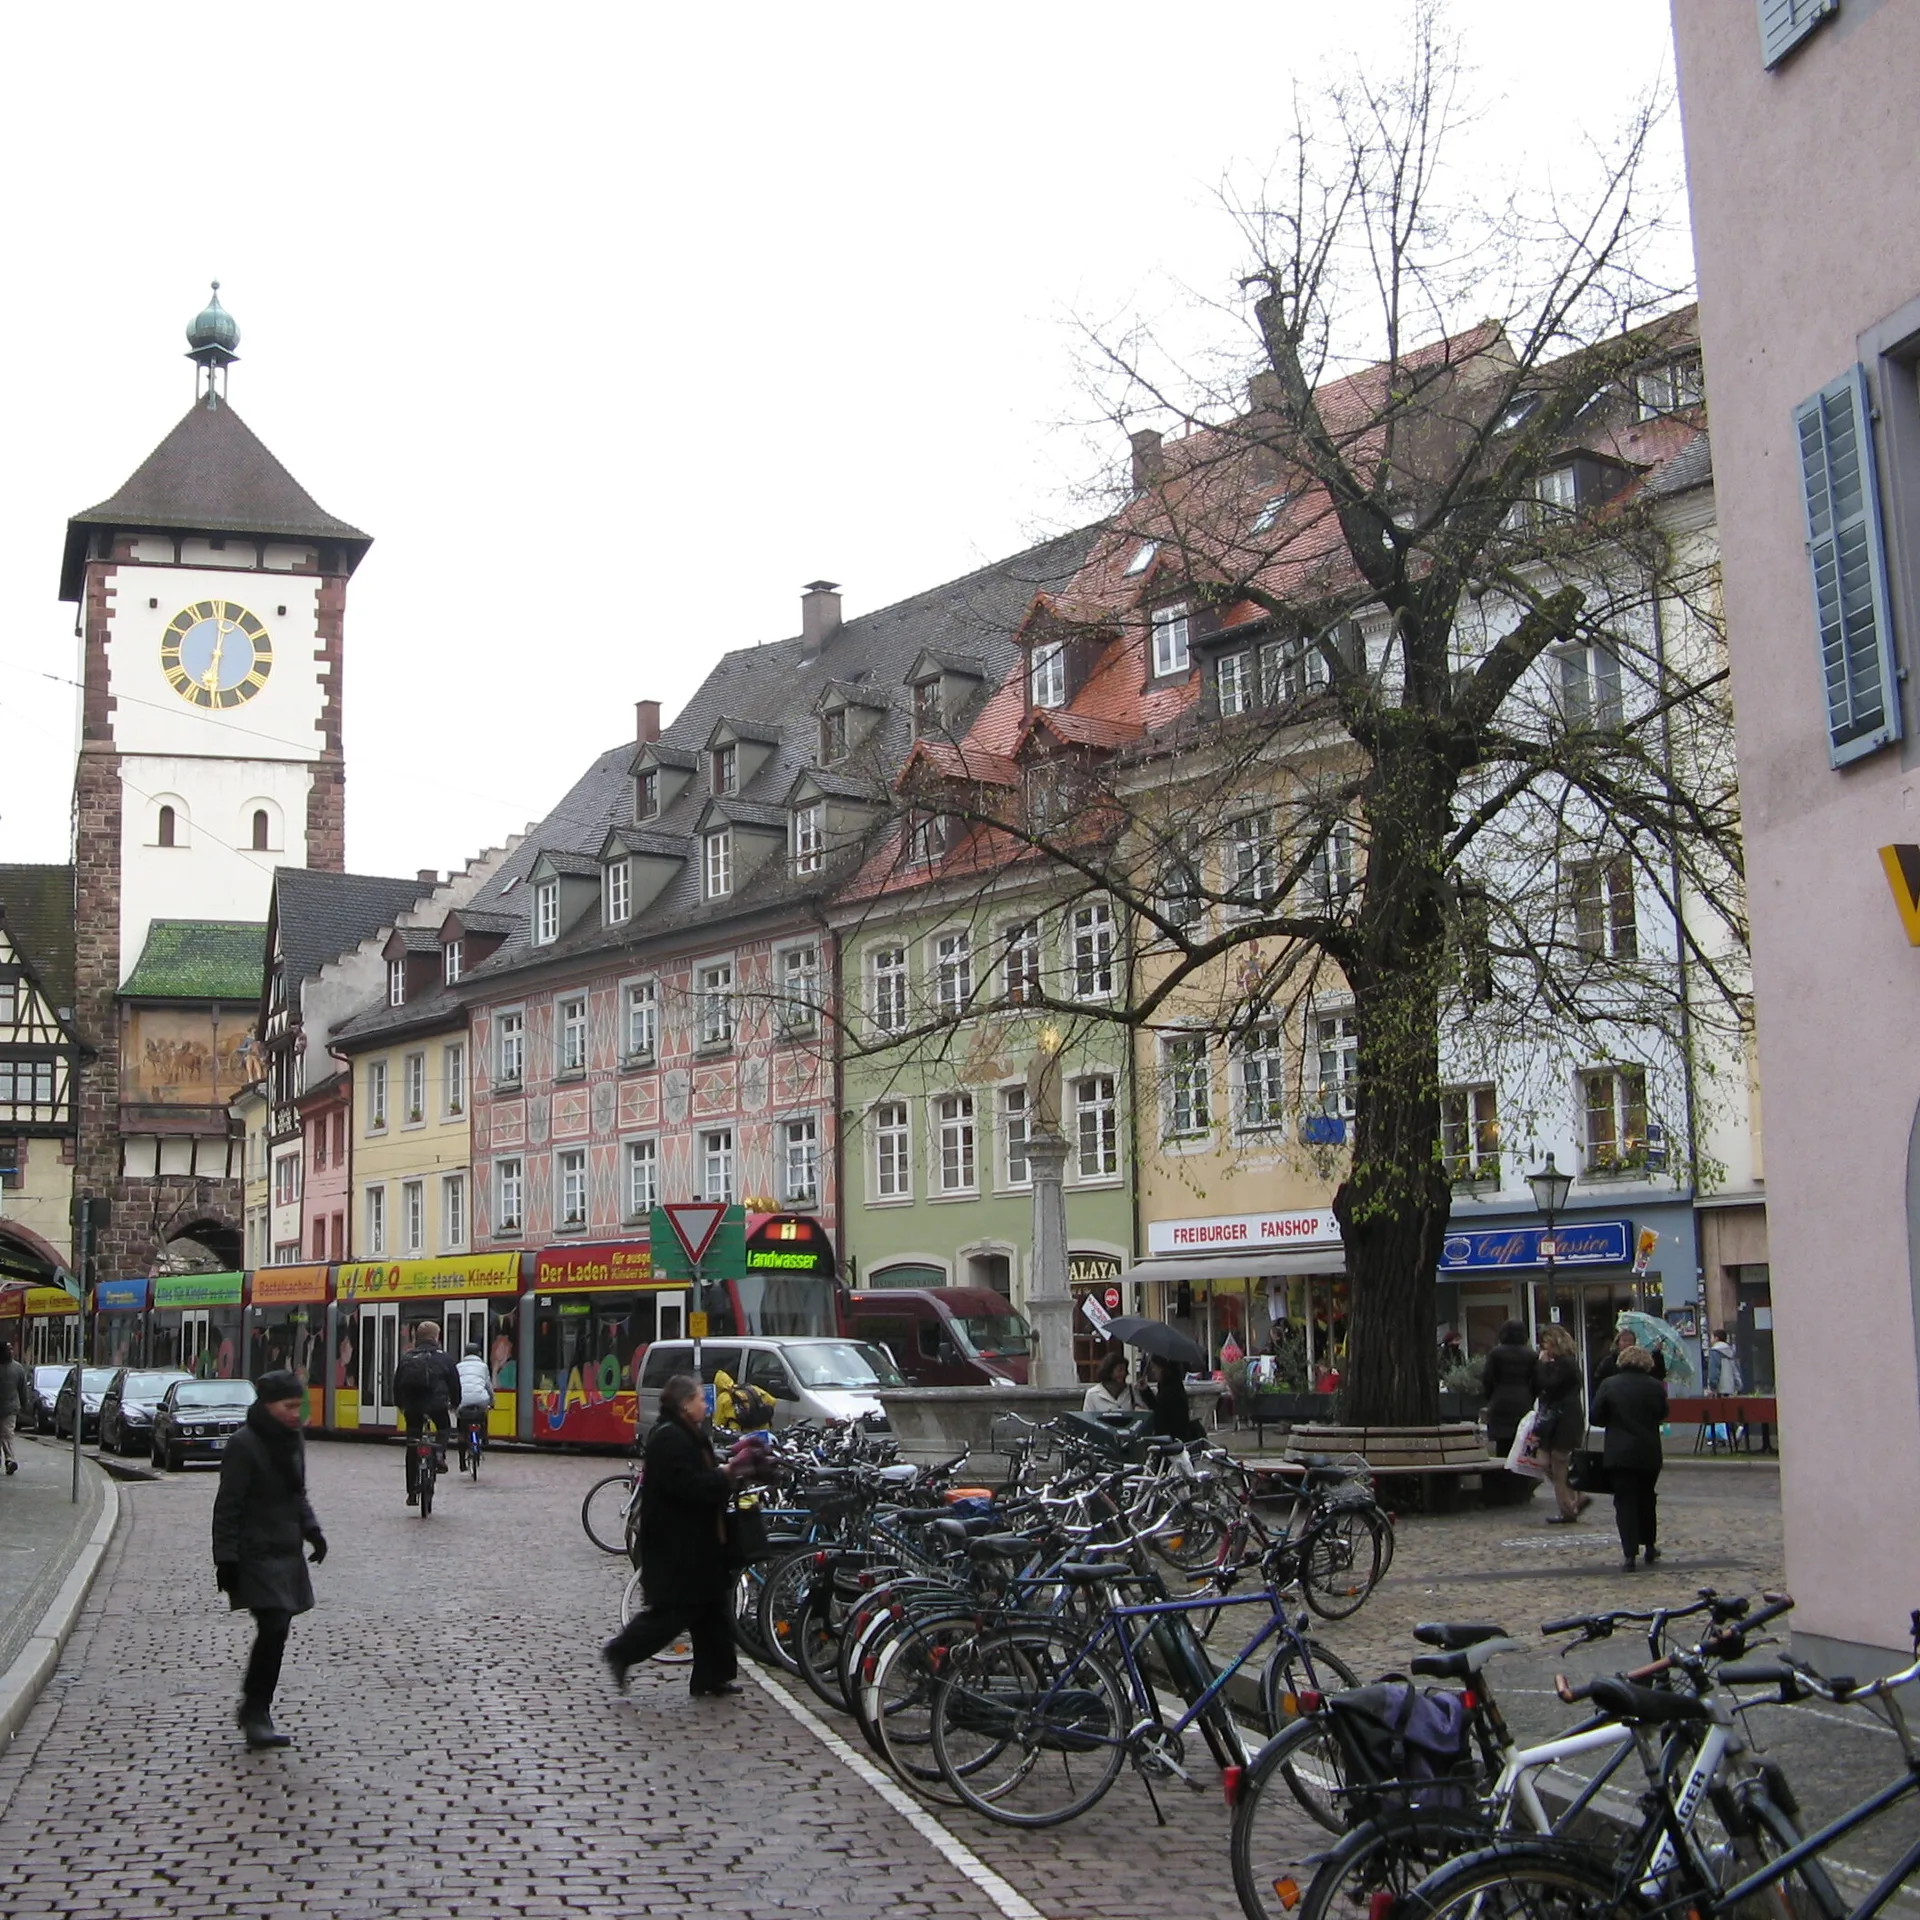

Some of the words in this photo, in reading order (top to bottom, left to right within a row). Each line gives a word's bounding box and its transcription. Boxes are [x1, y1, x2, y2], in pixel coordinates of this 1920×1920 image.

[1173, 1223, 1248, 1244] FREIBURGER
[1261, 1218, 1319, 1238] FANSHOP
[611, 1252, 624, 1265] für
[747, 1250, 818, 1269] Landwasser
[540, 1263, 564, 1282] Der
[567, 1261, 608, 1282] Laden
[1068, 1261, 1118, 1280] ALAYA
[431, 1272, 465, 1289] starke
[1652, 1770, 1706, 1877] STGER
